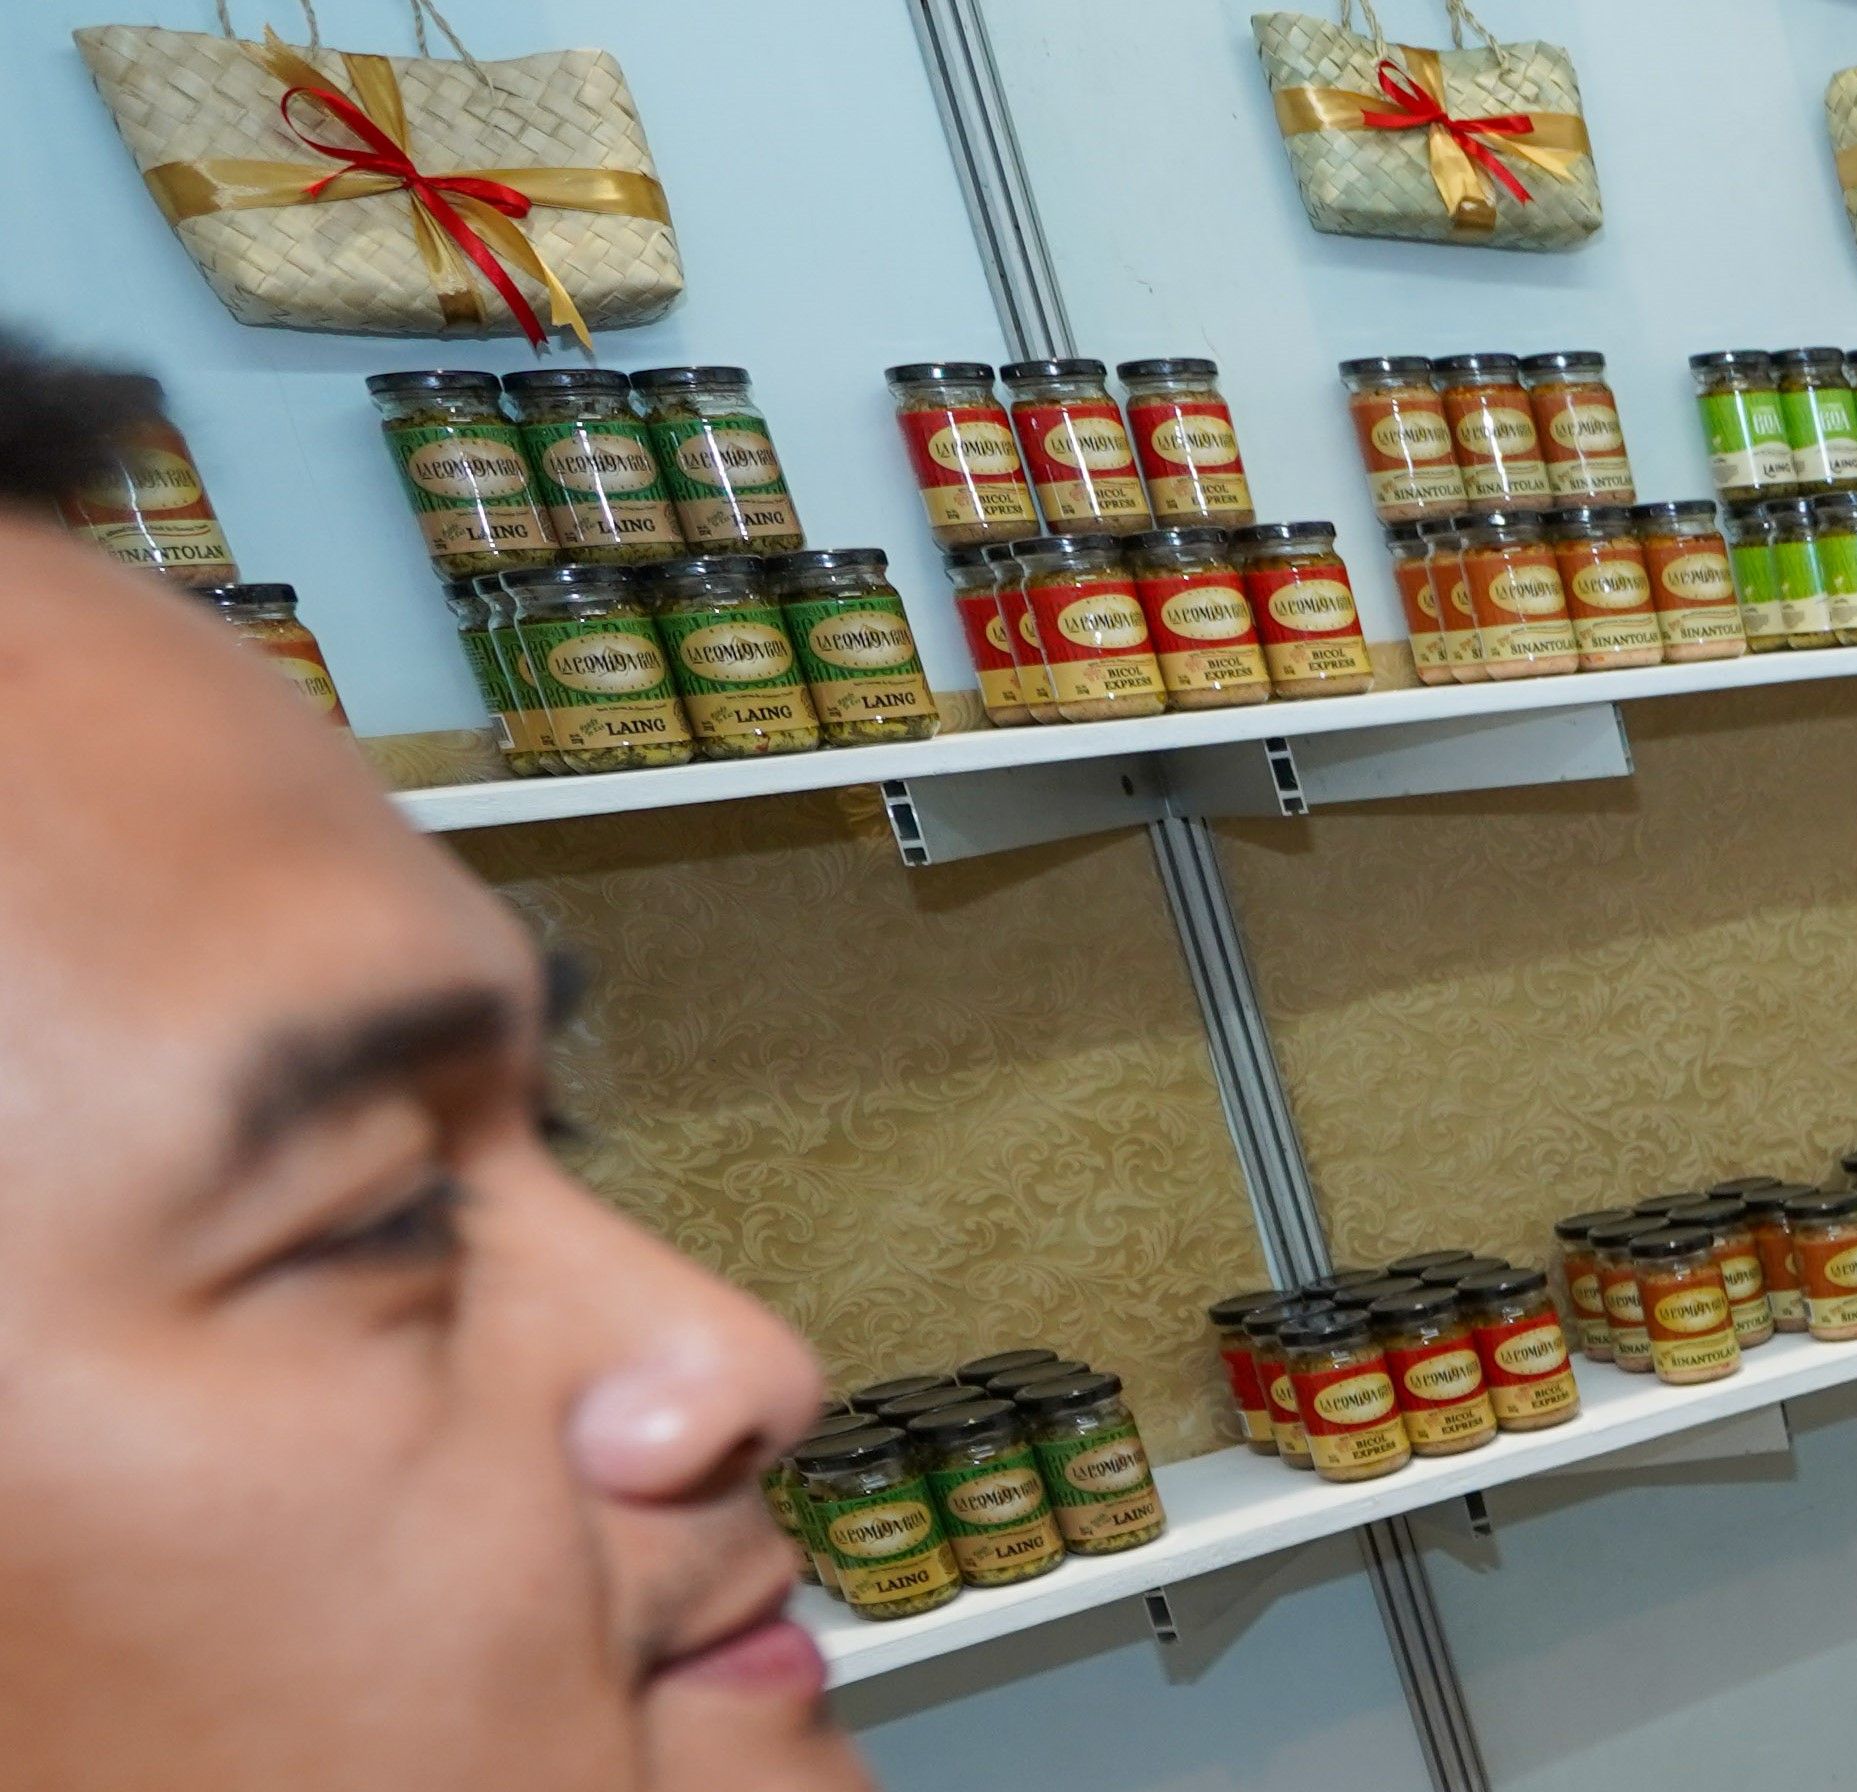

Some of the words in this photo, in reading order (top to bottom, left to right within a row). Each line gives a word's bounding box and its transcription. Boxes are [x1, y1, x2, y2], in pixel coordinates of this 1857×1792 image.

[466, 522, 529, 542] LAING
[687, 648, 704, 666] LA
[702, 643, 765, 666] COMIDA
[764, 640, 790, 659] GOA
[1312, 647, 1346, 661] BICOL
[555, 658, 573, 677] LA
[573, 653, 635, 676] COMIDA
[634, 653, 663, 672] GOA
[1207, 655, 1241, 670] BICOL
[1308, 658, 1356, 672] EXPRESS
[1107, 665, 1141, 679] BICOL
[1204, 665, 1253, 682] EXPRESS
[1103, 676, 1154, 691] EXPRESS
[862, 692, 918, 710] LAING
[735, 705, 794, 724] LAING
[605, 717, 668, 737] LAING
[1355, 1434, 1387, 1451] BICOL
[1113, 1503, 1156, 1525] LAING
[995, 1535, 1045, 1559] LAING
[875, 1569, 931, 1594] LAING
